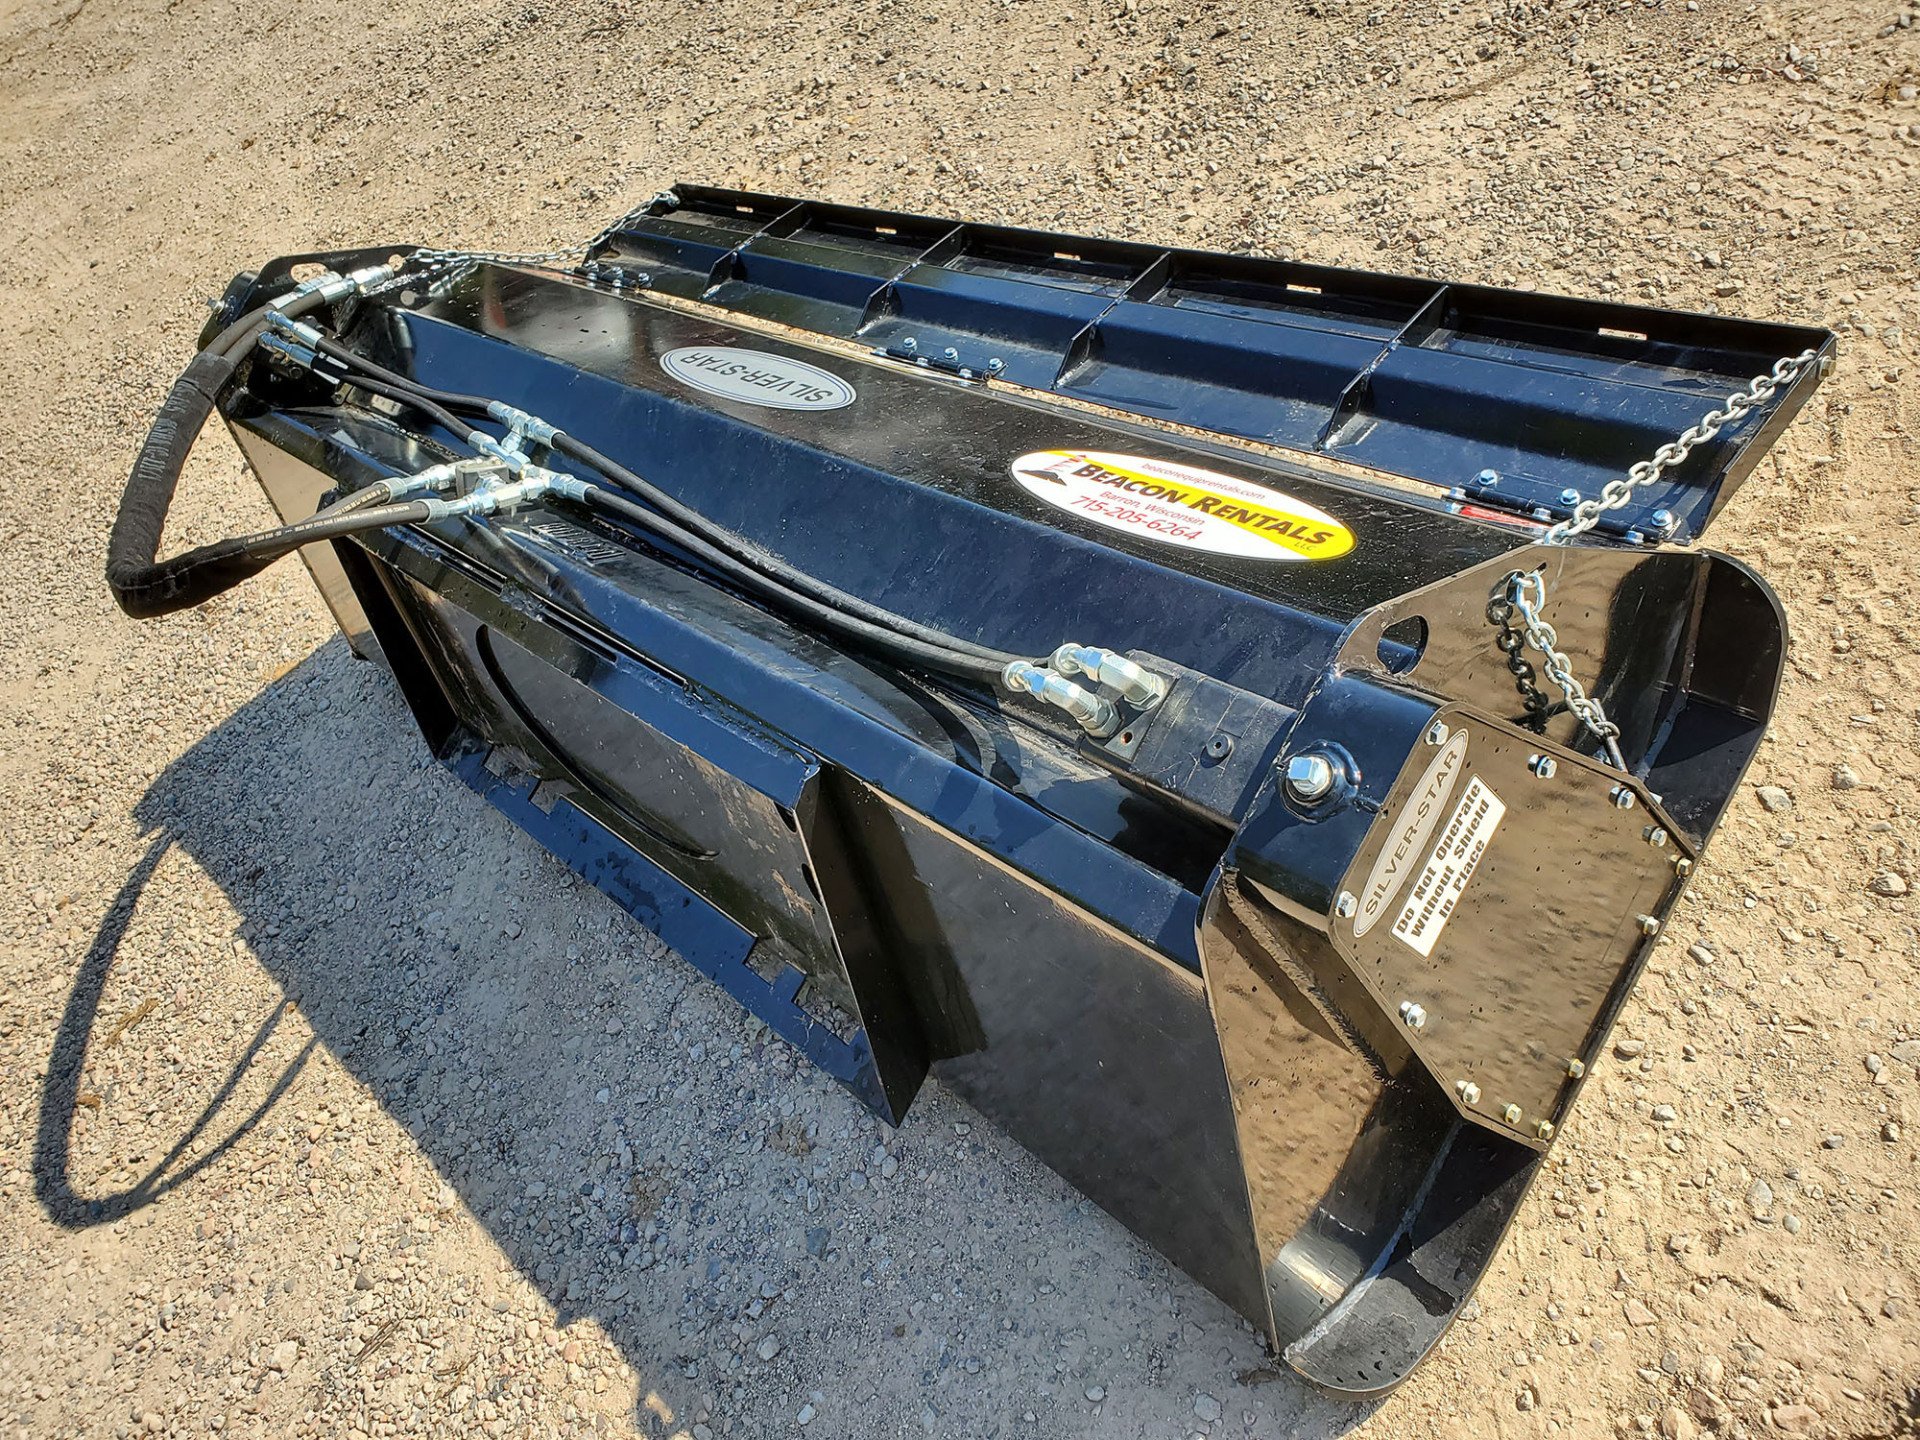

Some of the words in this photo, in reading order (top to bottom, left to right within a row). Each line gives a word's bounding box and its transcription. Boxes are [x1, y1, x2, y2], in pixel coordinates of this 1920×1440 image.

[680, 352, 834, 402] SILVER-STAR
[1070, 463, 1189, 504] BEACON
[1188, 495, 1335, 545] RENTALS
[1099, 490, 1142, 508] Barron,
[1144, 503, 1205, 526] Wisconsin
[1141, 463, 1266, 500] beaconequiprentals.com
[1070, 495, 1202, 540] 715-205-6264
[1293, 541, 1317, 552] LLC
[1365, 749, 1458, 916] SILVER-STAR
[1396, 906, 1415, 934] Do
[1413, 866, 1437, 901] Not
[1435, 783, 1481, 861] Operate
[1411, 865, 1455, 938] Without
[1453, 799, 1490, 860] Shield
[1438, 897, 1454, 920] In
[1452, 839, 1485, 892] Place
